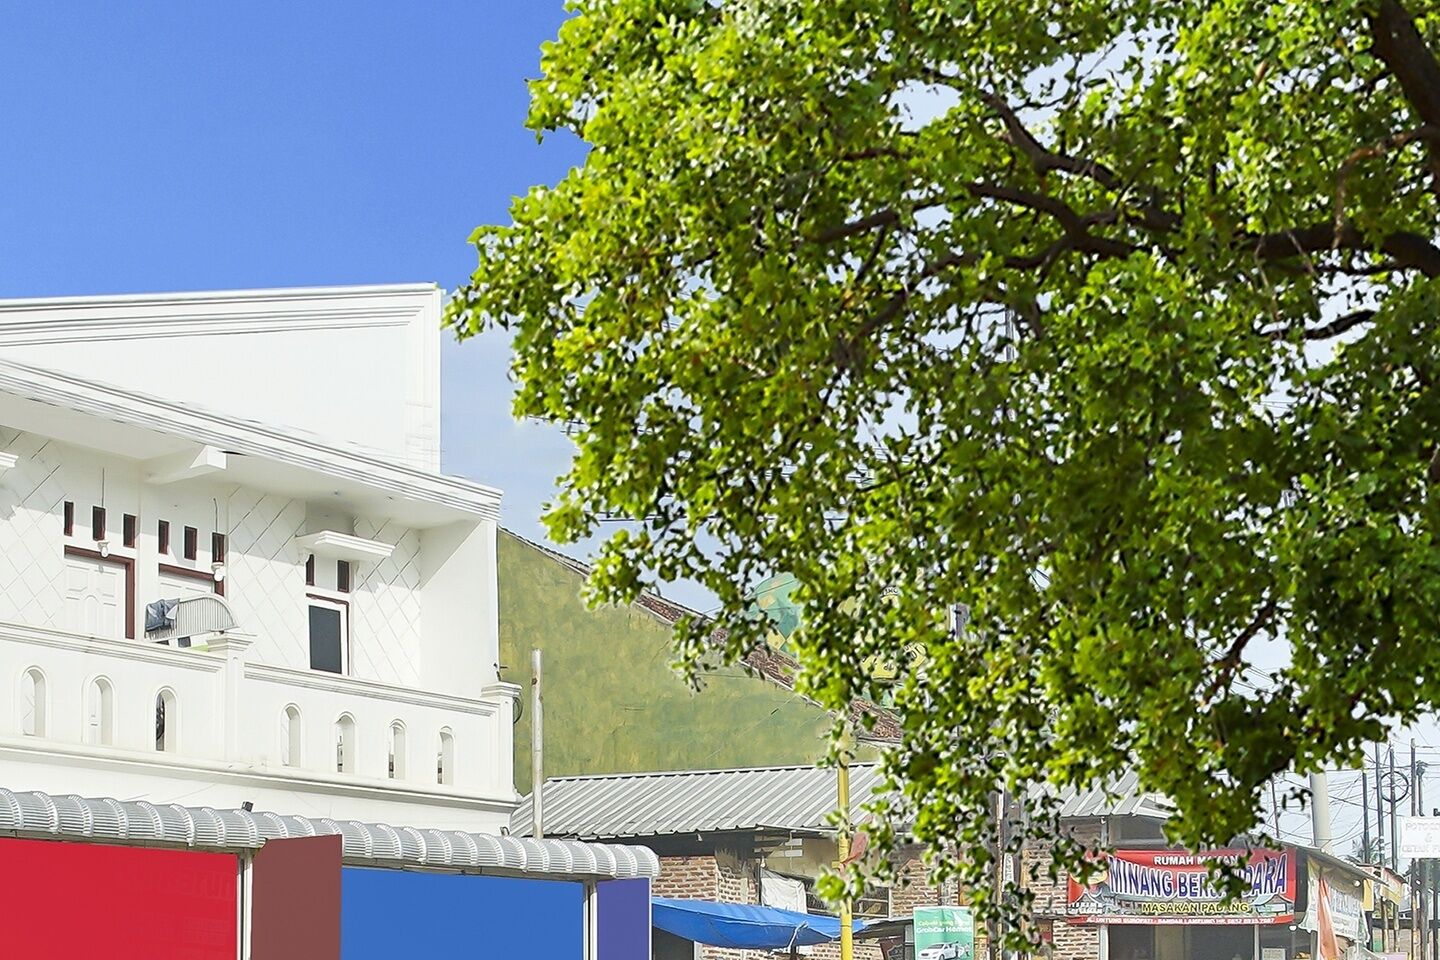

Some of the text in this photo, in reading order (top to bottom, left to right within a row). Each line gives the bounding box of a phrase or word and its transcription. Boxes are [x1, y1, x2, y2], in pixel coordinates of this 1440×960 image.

[1154, 855, 1239, 867] RUMAH MAN
[1107, 855, 1172, 898] MINANG
[1141, 902, 1199, 913] MASAKAN
